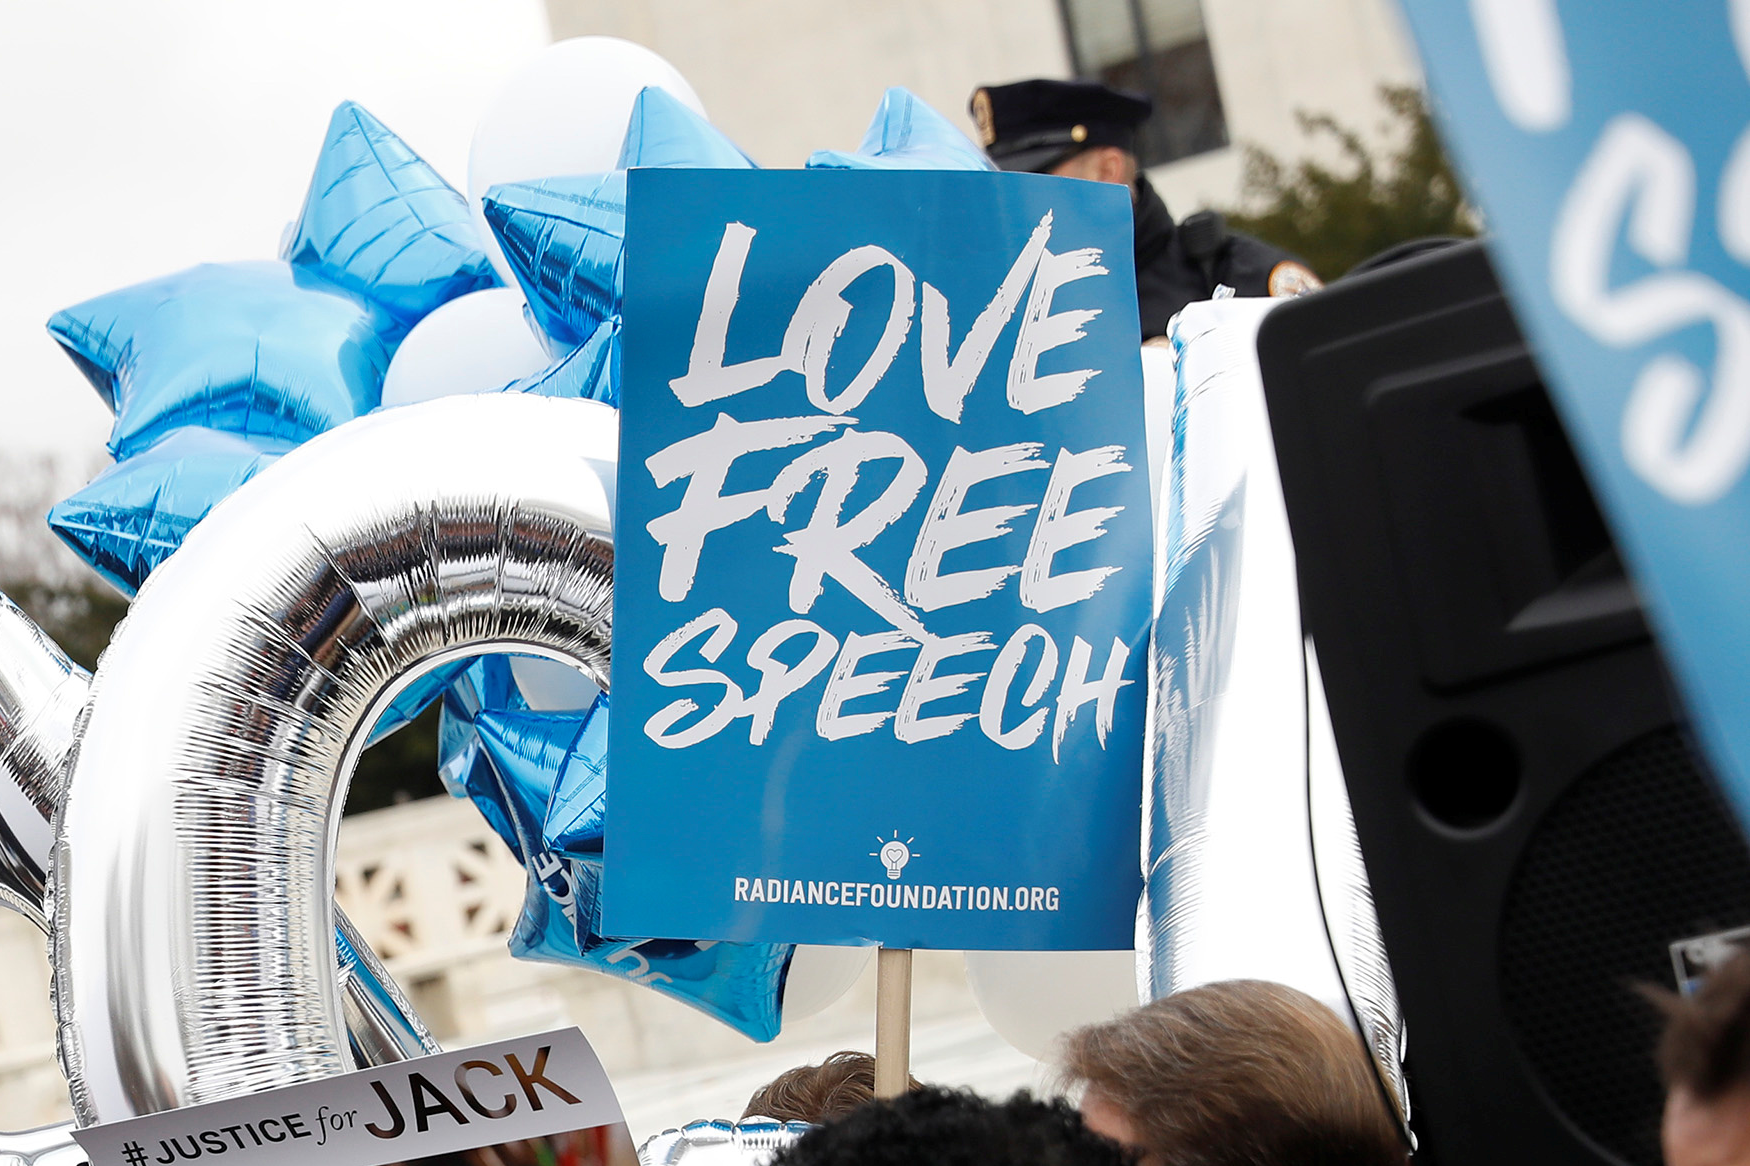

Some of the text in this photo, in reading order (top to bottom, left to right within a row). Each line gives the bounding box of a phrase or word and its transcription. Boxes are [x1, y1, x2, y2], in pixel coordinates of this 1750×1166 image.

[668, 208, 1109, 424] LOVE
[644, 412, 1133, 635] FREE
[643, 608, 1133, 763] SPEECH
[734, 877, 1060, 912] RADIANCEFOUNDATION.ORG
[316, 1105, 359, 1147] for
[364, 1046, 583, 1140] JACK
